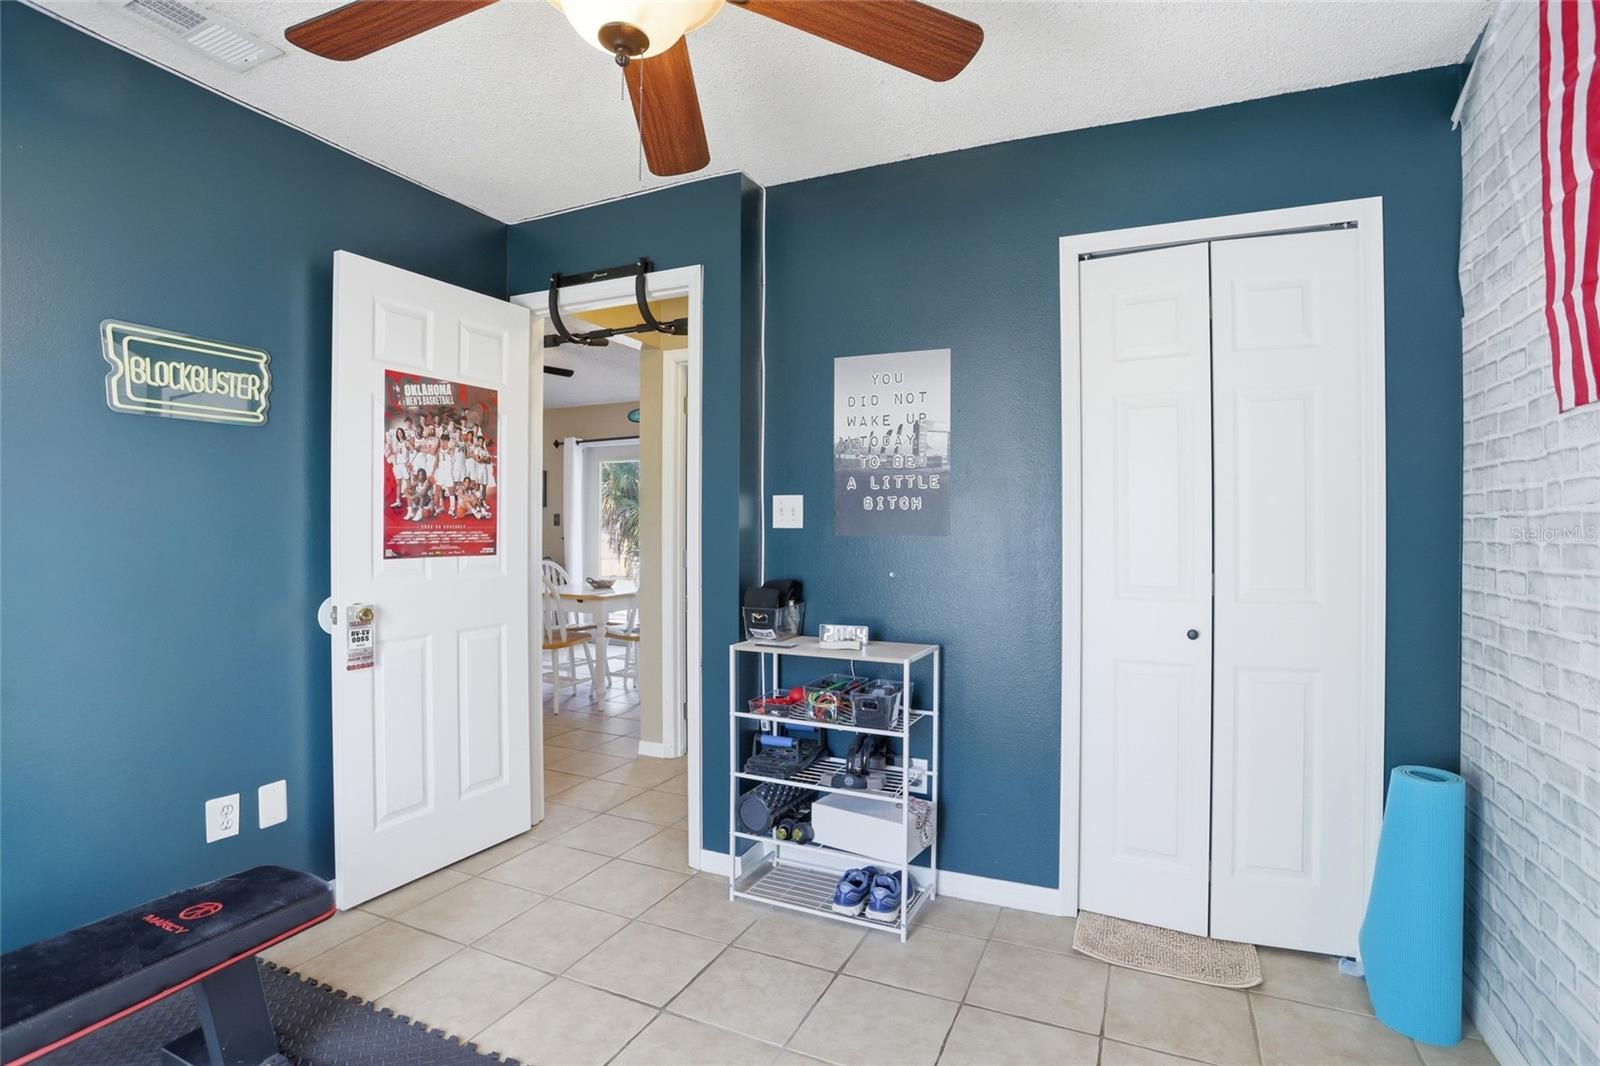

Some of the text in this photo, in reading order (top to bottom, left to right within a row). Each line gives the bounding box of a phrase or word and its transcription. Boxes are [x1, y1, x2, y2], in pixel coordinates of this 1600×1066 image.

[130, 356, 261, 401] BLOCKBUSTER
[871, 372, 904, 385] YOU
[404, 383, 452, 396] OKLAHOMA
[405, 395, 455, 406] MEN'S BASKETBALL
[848, 390, 927, 408] DID NOT
[846, 412, 927, 427] WAKE UP
[859, 434, 916, 448] TODAY
[858, 454, 917, 469] TO BE
[846, 474, 940, 490] A LITTLE
[863, 496, 922, 511] BITCH
[143, 914, 189, 934] MARCY
